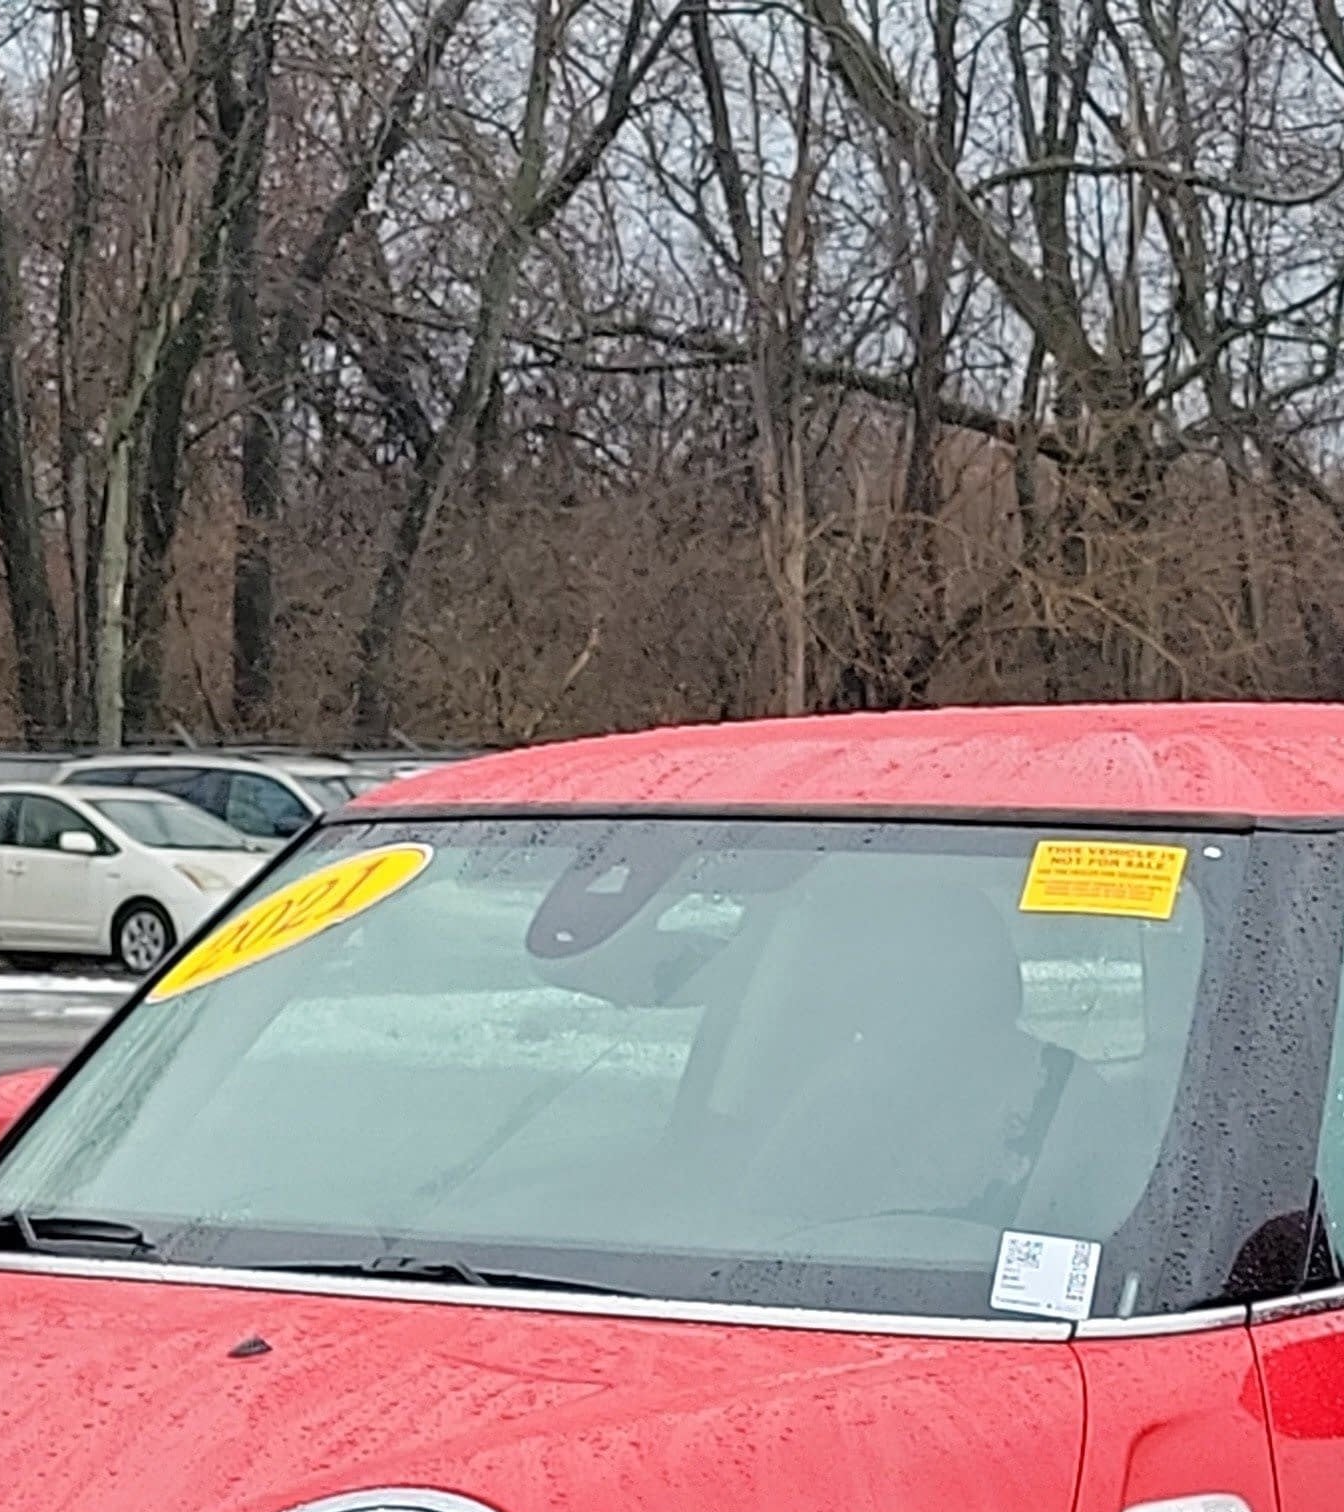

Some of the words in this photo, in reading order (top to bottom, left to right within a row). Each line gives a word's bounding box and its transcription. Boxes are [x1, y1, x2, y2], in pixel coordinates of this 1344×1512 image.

[1088, 847, 1154, 859] VEHICLE
[1050, 856, 1082, 866] NOT
[1088, 857, 1120, 868] FOR
[1126, 859, 1165, 870] SALE
[181, 856, 389, 983] 2021
